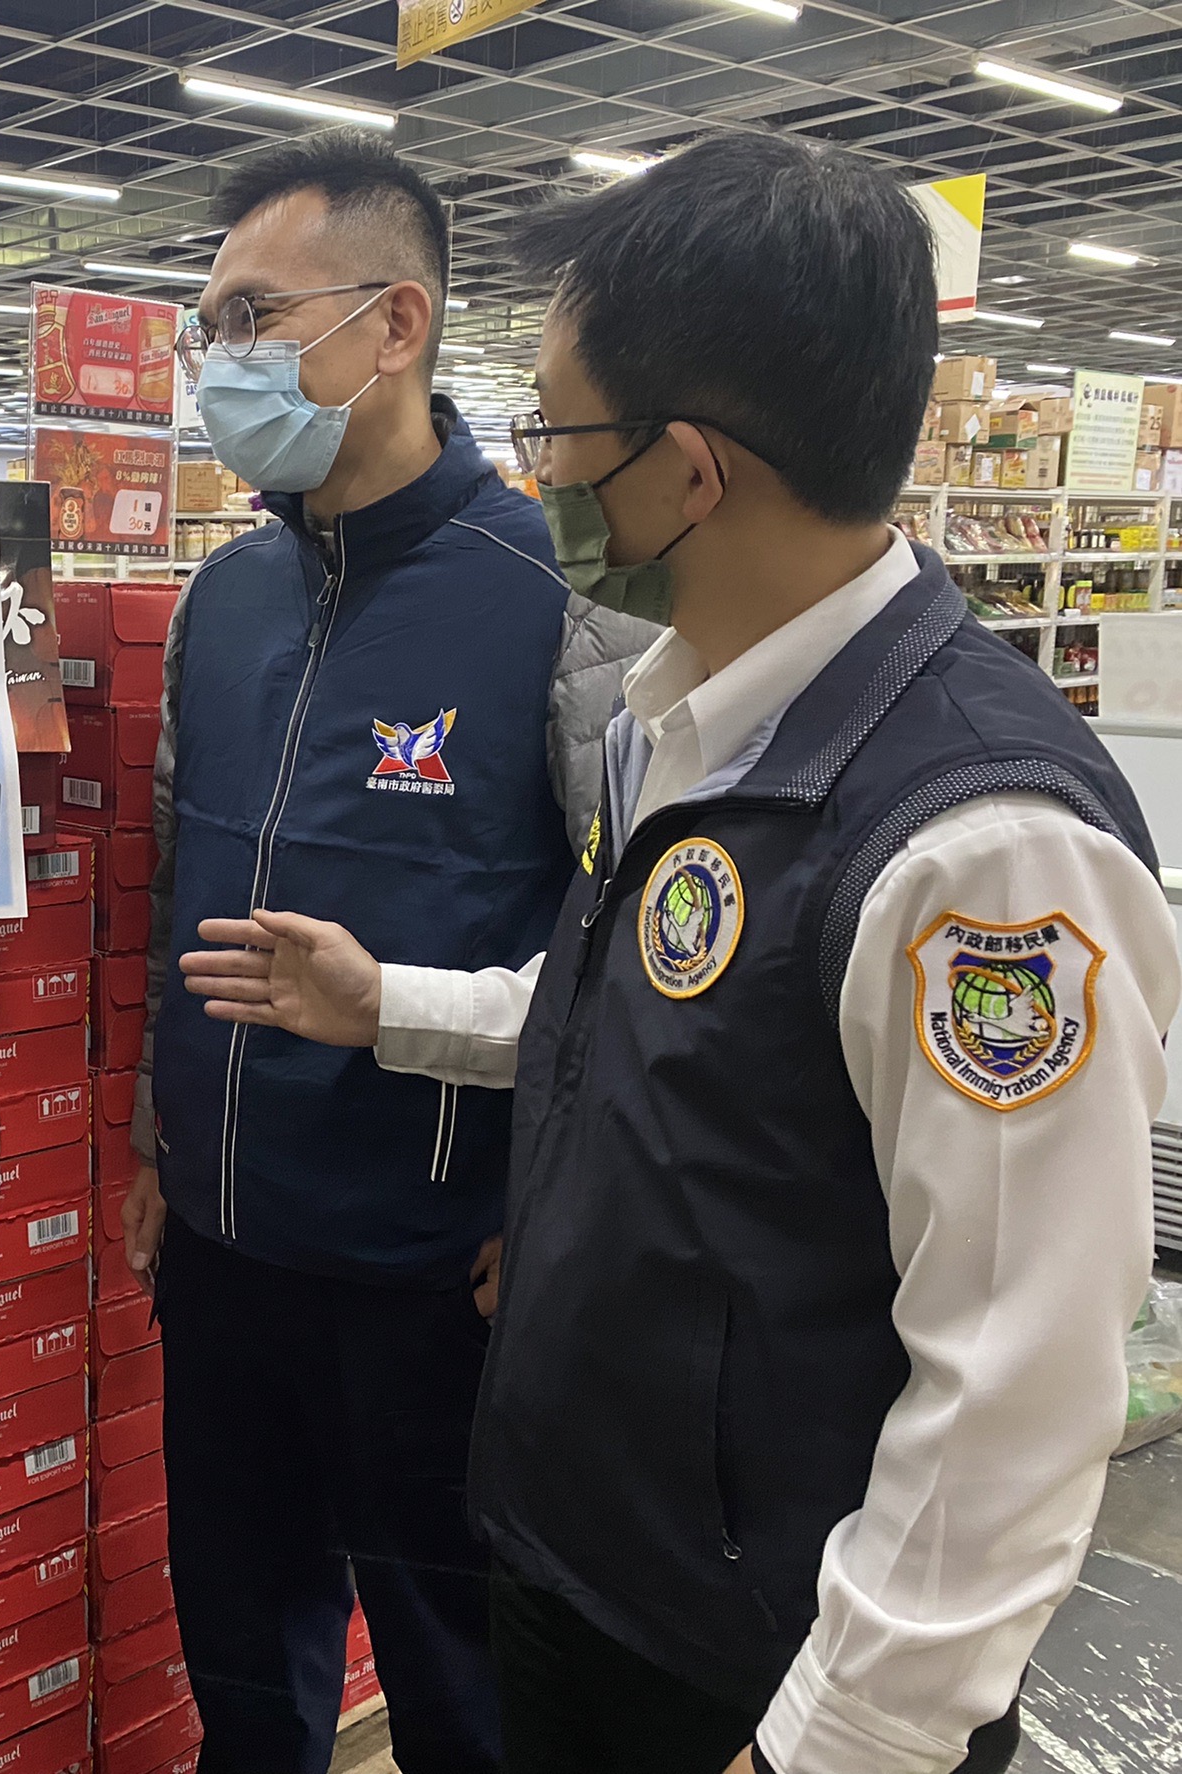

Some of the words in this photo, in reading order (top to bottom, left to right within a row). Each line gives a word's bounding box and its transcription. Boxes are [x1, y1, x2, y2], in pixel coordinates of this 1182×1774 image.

[128, 516, 143, 530] 30
[365, 776, 455, 796] 臺南市政府警察局
[945, 924, 1060, 953] 內政部移民署
[687, 956, 717, 985] Agency
[930, 1011, 965, 1069] National
[957, 1061, 1051, 1099] Immigration
[1044, 1017, 1080, 1072] Agency
[30, 1248, 43, 1256] FOR
[43, 1242, 64, 1254] EXPORT
[64, 1237, 80, 1249] ONLY
[28, 1477, 40, 1486] FOR
[61, 1463, 77, 1476] ONLY
